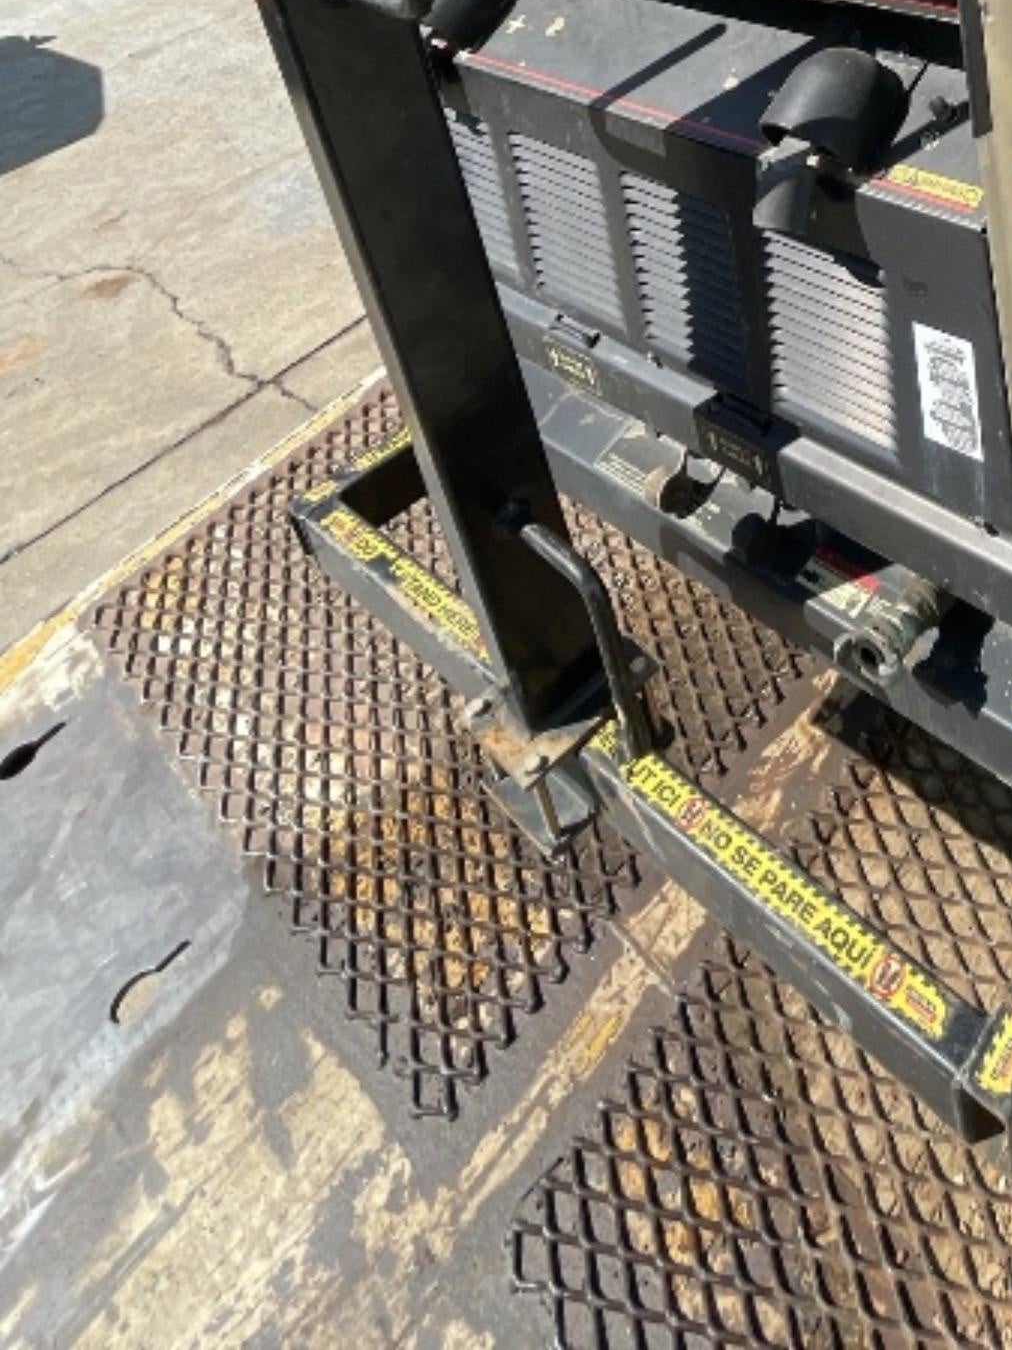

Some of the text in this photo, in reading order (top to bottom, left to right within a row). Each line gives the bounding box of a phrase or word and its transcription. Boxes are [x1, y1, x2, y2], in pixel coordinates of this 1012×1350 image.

[649, 779, 682, 809] ICI
[700, 819, 732, 851] NO
[731, 845, 763, 877] SE
[759, 869, 818, 925] PARE
